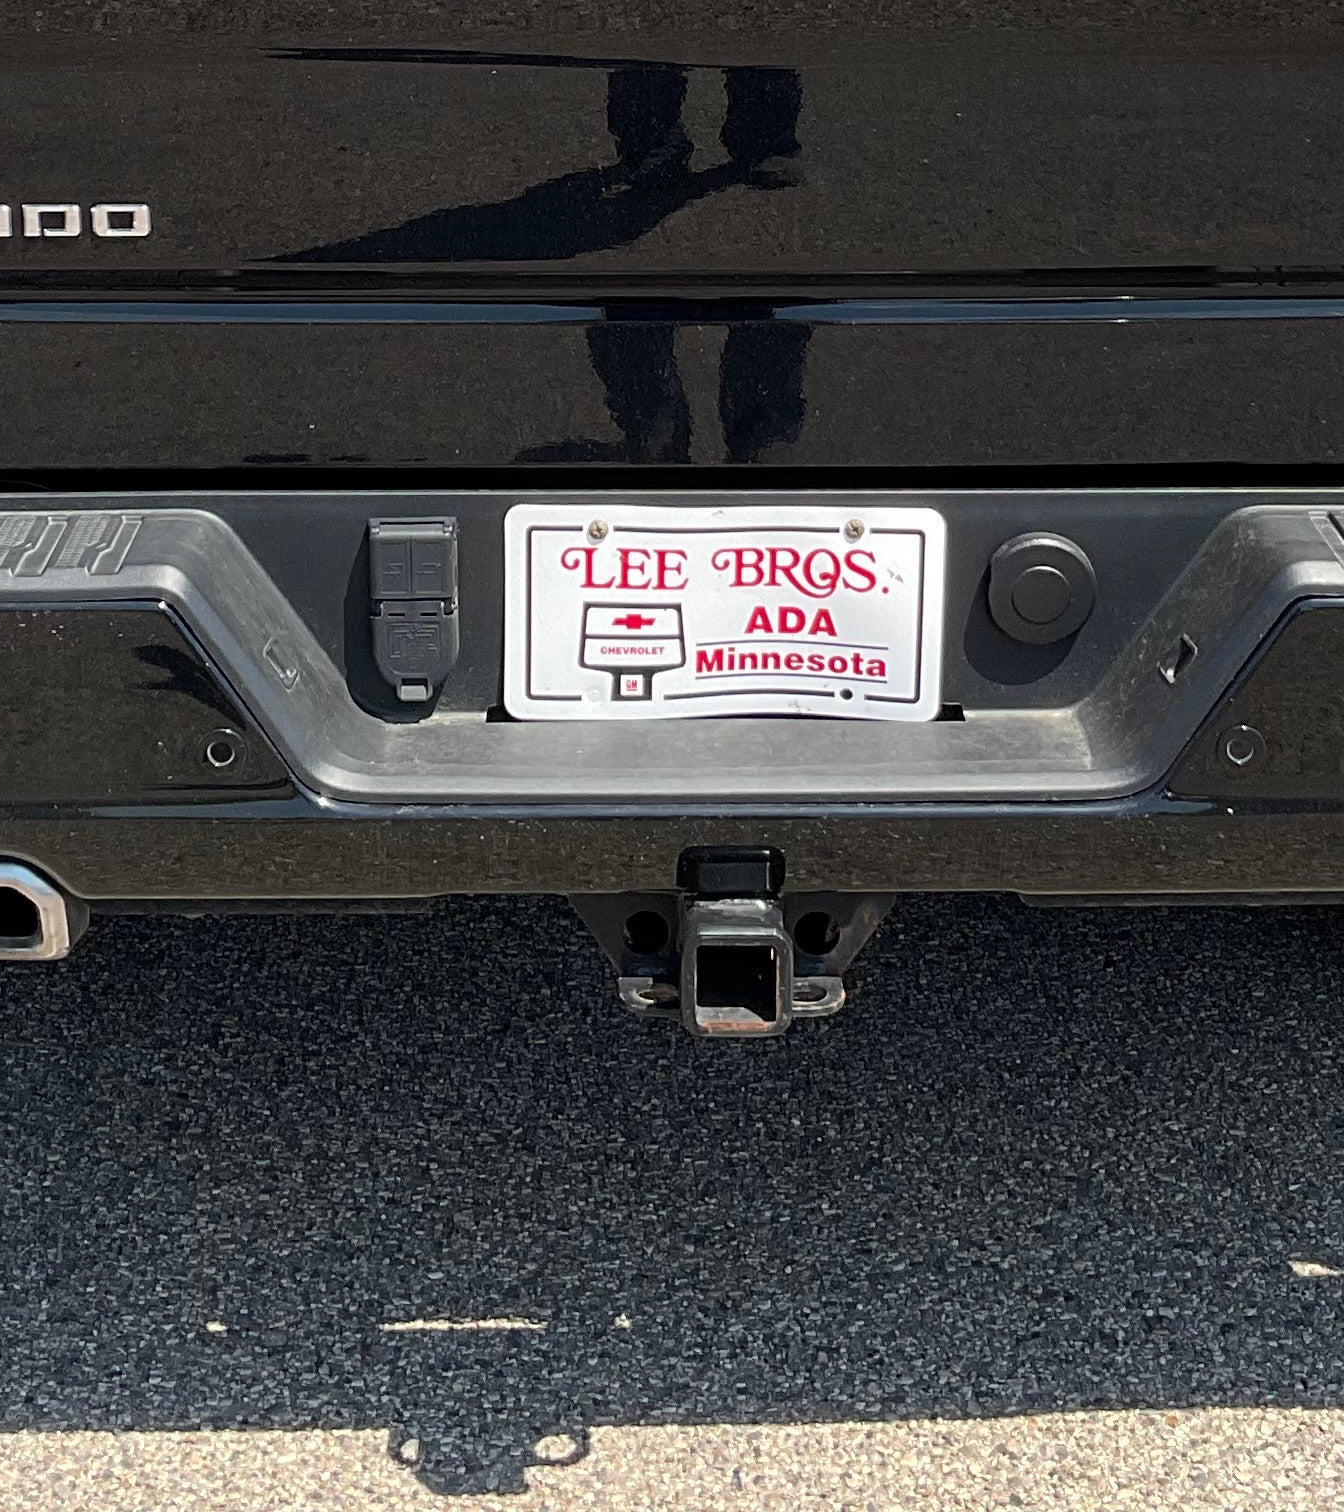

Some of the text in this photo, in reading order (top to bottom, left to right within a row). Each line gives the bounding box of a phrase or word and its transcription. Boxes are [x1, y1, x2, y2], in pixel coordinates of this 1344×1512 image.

[561, 547, 889, 599] LEE BROS.
[744, 606, 838, 637] ADA
[600, 646, 665, 655] CHEVROLET
[695, 647, 886, 677] Minnesota
